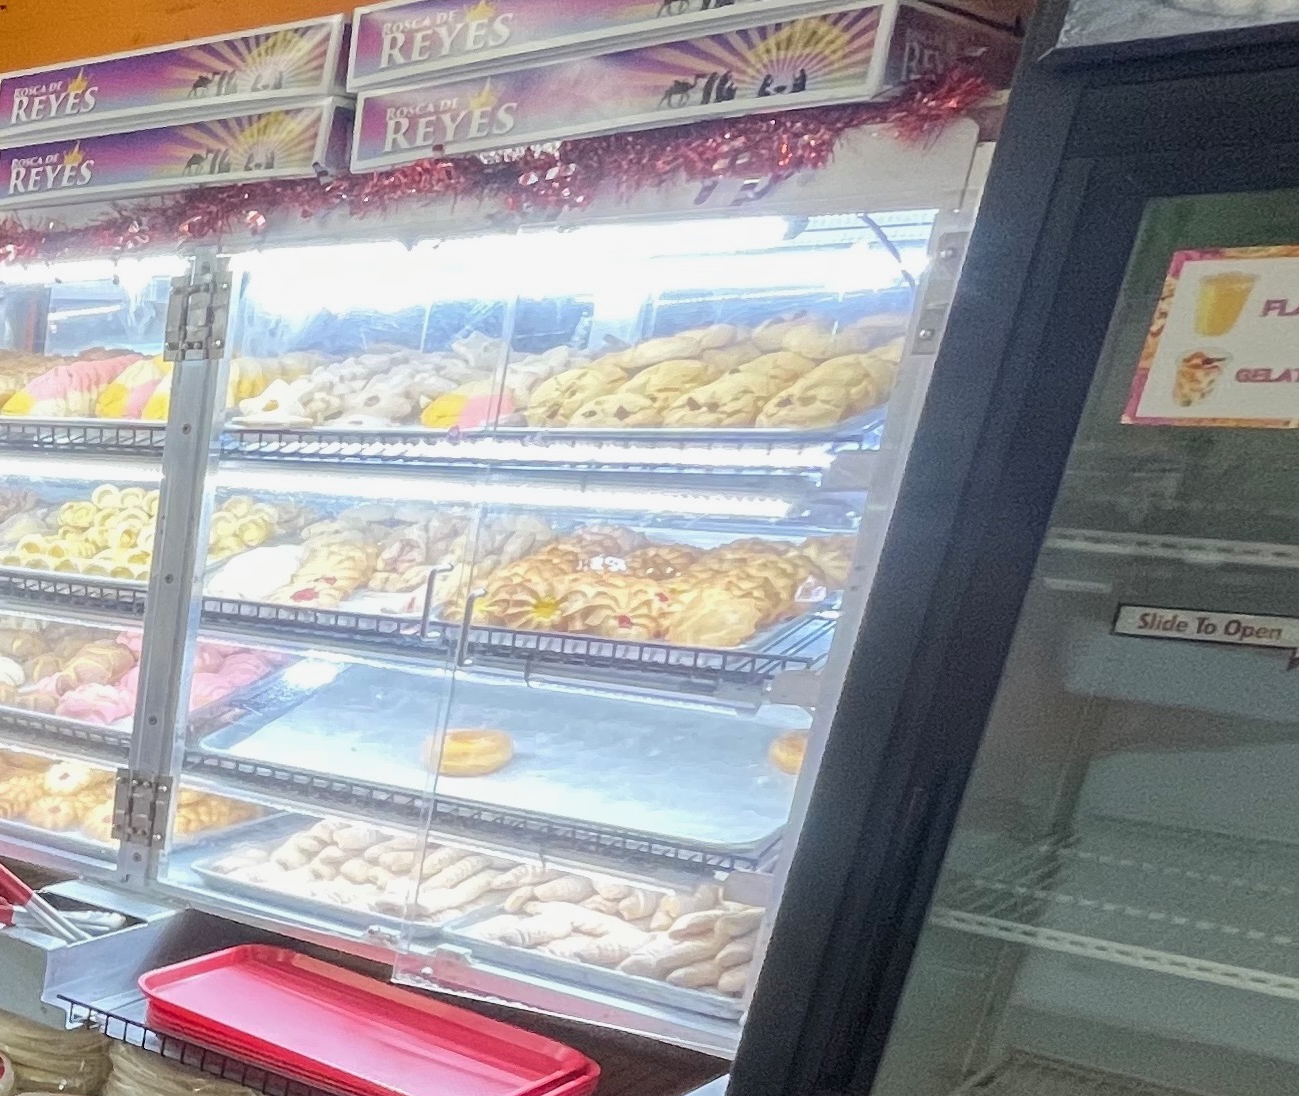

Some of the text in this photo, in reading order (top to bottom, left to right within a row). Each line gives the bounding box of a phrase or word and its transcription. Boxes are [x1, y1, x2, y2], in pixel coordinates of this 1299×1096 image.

[383, 9, 457, 34] ROSCA DE
[380, 13, 513, 68] REYES
[11, 86, 98, 124] REYES
[14, 80, 64, 98] ROSCA DE
[386, 97, 458, 119] ROSCA DE
[383, 102, 517, 152] REYES
[8, 159, 94, 195] REYES
[1138, 612, 1283, 641] Slide To Open
